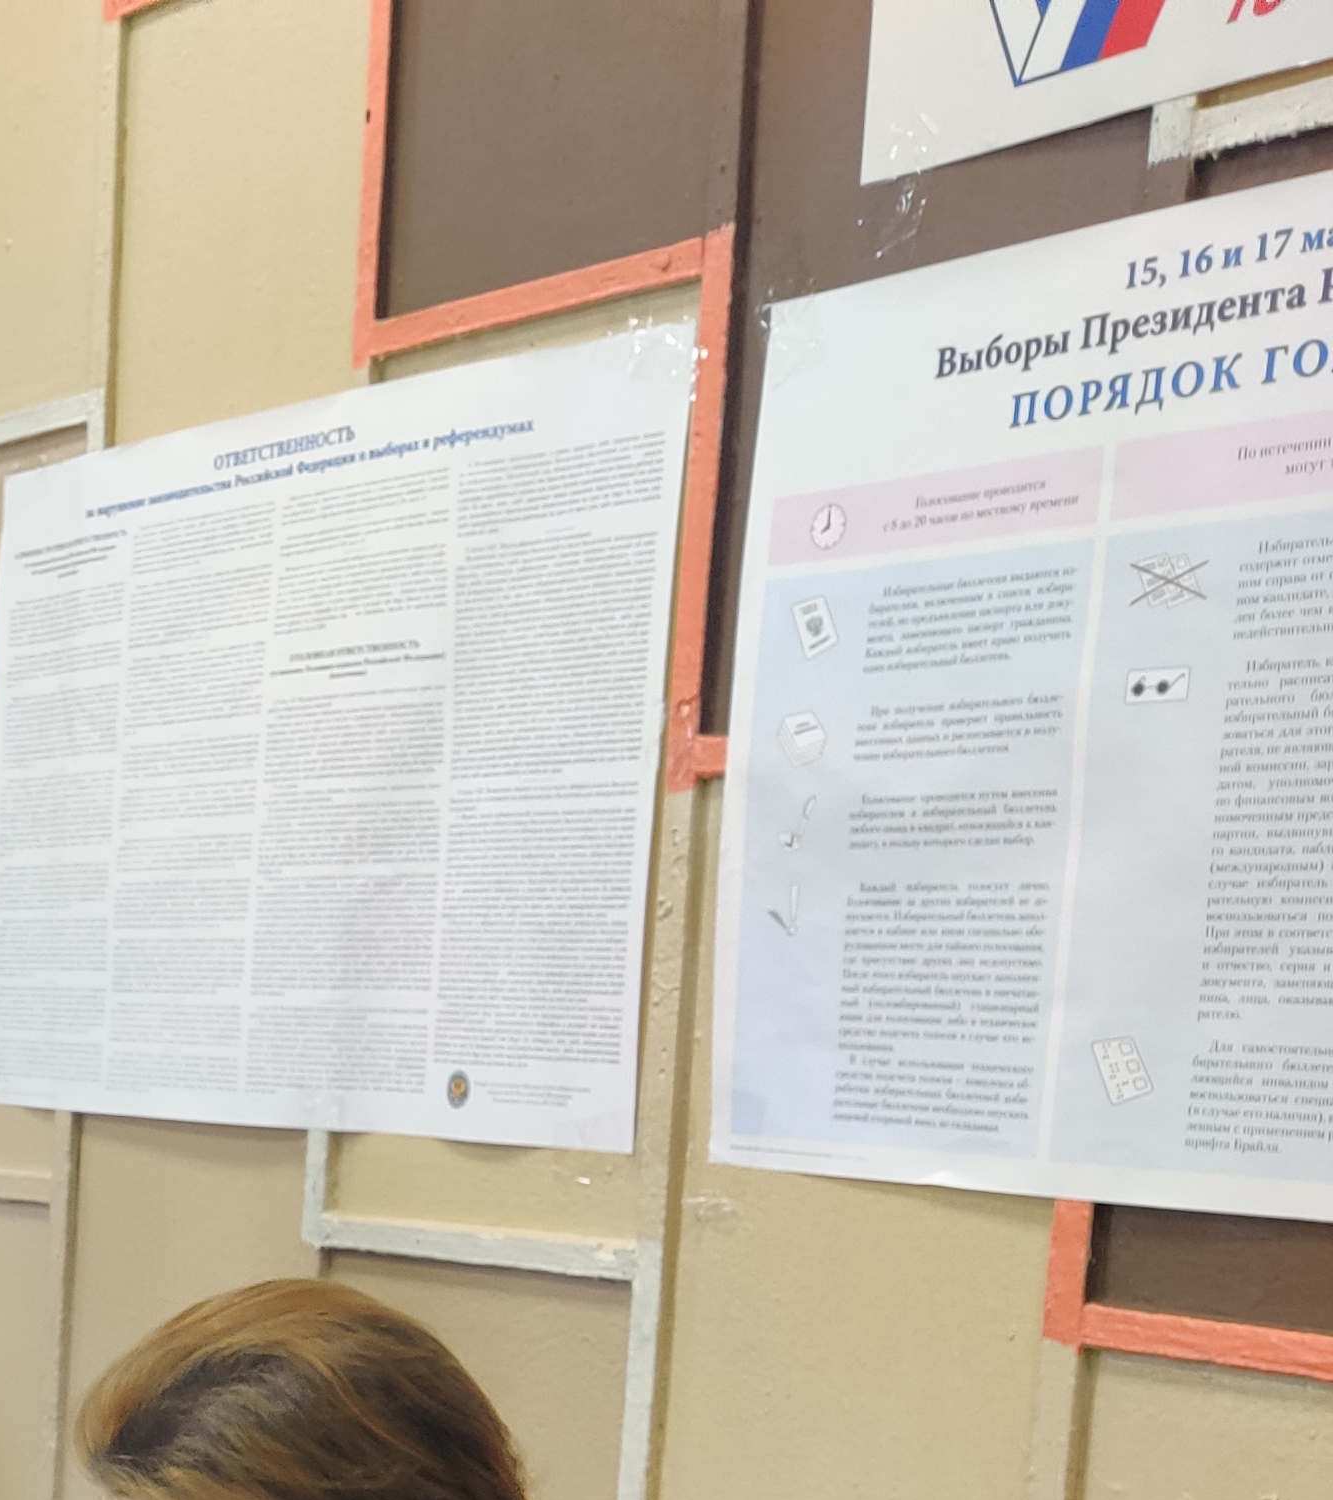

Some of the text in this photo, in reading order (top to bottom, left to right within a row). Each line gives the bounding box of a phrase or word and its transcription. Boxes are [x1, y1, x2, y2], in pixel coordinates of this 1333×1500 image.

[1126, 256, 1167, 289] 15,
[1179, 243, 1214, 279] 16
[1221, 245, 1244, 269] и
[1256, 228, 1293, 262] 17
[935, 330, 1071, 380] Выборы
[1079, 283, 1306, 355] Президента
[1009, 338, 1333, 429] ПОРЯДОК ГО
[213, 425, 356, 471] ОТВЕТСТВЕННОСТЬ
[234, 463, 294, 488] Российской
[297, 453, 356, 474] Федерации
[369, 440, 420, 459] выборах
[433, 419, 535, 451] референдумах
[1238, 446, 1256, 460] По
[1285, 461, 1324, 474] могут
[914, 515, 927, 528] 20
[1030, 496, 1079, 512] времени
[1239, 558, 1297, 573] содержит
[1265, 574, 1306, 588] справа
[1310, 572, 1323, 581] от
[1260, 608, 1295, 620] более
[1300, 606, 1323, 617] чем
[1233, 623, 1333, 640] недействительн
[1228, 679, 1269, 691] тельно
[1226, 694, 1294, 710] рательного
[1224, 709, 1318, 725] избирательный
[1278, 727, 1301, 738] для
[1267, 746, 1281, 754] не
[1219, 762, 1241, 773] ной
[1246, 762, 1310, 772] комиссии,
[1235, 794, 1314, 808] финансовым
[1213, 830, 1259, 842] партии,
[1229, 845, 1295, 857] кандидата,
[1210, 860, 1324, 875] (международным)
[1209, 876, 1328, 891] случае избиратель
[1208, 897, 1272, 908] рательную
[1206, 926, 1229, 940] При
[1234, 929, 1262, 938] этом
[1203, 941, 1278, 957] избирателей
[1202, 961, 1209, 970] и
[1217, 962, 1272, 971] отчество,
[1281, 963, 1316, 974] серия
[1200, 979, 1266, 988] документа,
[1209, 1039, 1233, 1053] Для
[1261, 1077, 1329, 1089] инвалидом
[1202, 1106, 1241, 1119] случае
[1243, 1126, 1325, 1139] применением
[1185, 1137, 1231, 1152] шрифта
